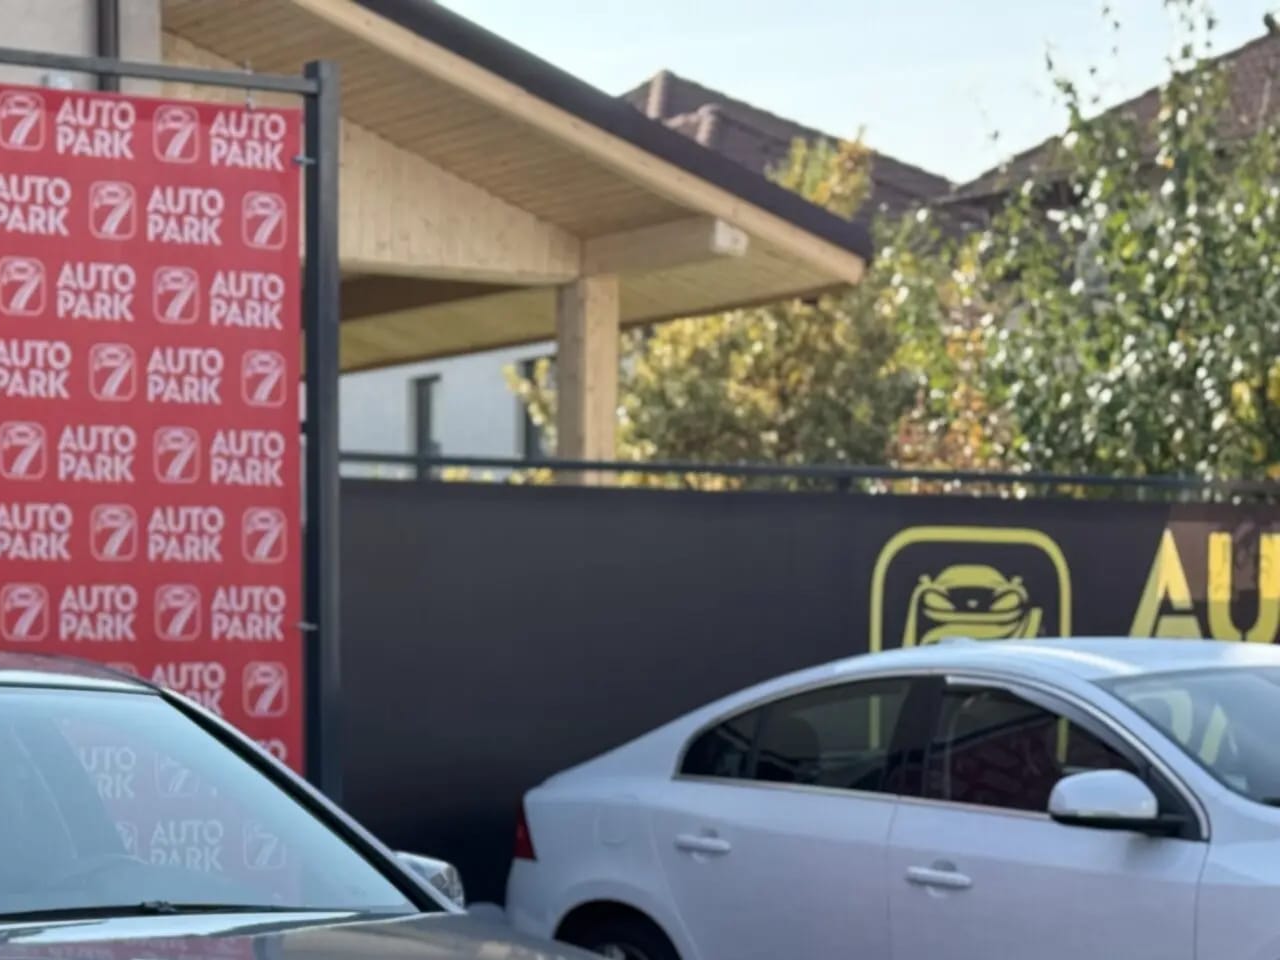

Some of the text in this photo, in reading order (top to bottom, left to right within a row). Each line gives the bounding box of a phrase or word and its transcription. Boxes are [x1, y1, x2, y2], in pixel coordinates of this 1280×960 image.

[55, 97, 136, 131] AUTO
[209, 110, 286, 141] AUTO
[56, 121, 134, 159] PARK
[210, 136, 283, 171] PARK
[147, 187, 224, 216] AUTO
[145, 214, 224, 245] PARK
[58, 263, 136, 294] AUTO
[209, 272, 284, 301] AUTO
[56, 288, 134, 320] PARK
[209, 296, 284, 327] PARK
[147, 348, 224, 376] AUTO
[146, 375, 223, 404] PARK
[58, 425, 137, 455] AUTO
[210, 430, 285, 458] AUTO
[57, 452, 135, 480] PARK
[210, 457, 283, 484] PARK
[148, 507, 226, 535] AUTO
[147, 534, 223, 561] PARK
[60, 585, 138, 612] AUTO
[211, 586, 285, 615] AUTO
[58, 610, 136, 640] PARK
[210, 614, 285, 640] PARK
